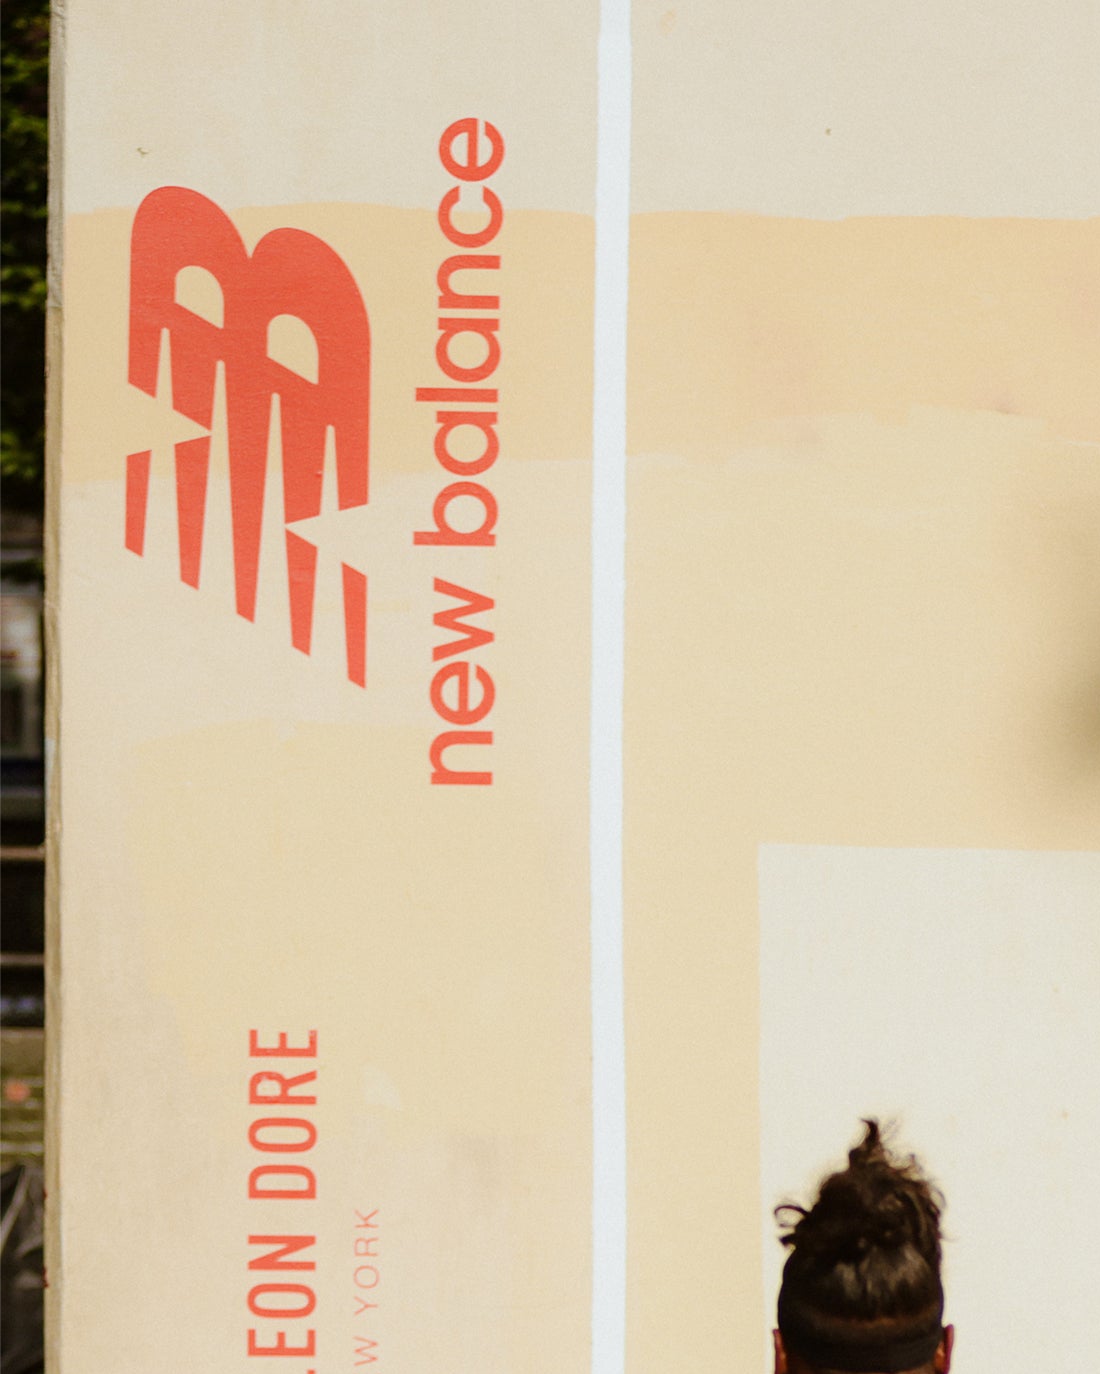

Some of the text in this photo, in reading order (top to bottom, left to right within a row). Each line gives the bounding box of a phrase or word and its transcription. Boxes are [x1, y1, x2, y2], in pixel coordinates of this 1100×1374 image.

[412, 116, 507, 787] new balance
[246, 1028, 319, 1201] DORE
[353, 1207, 381, 1317] YORK
